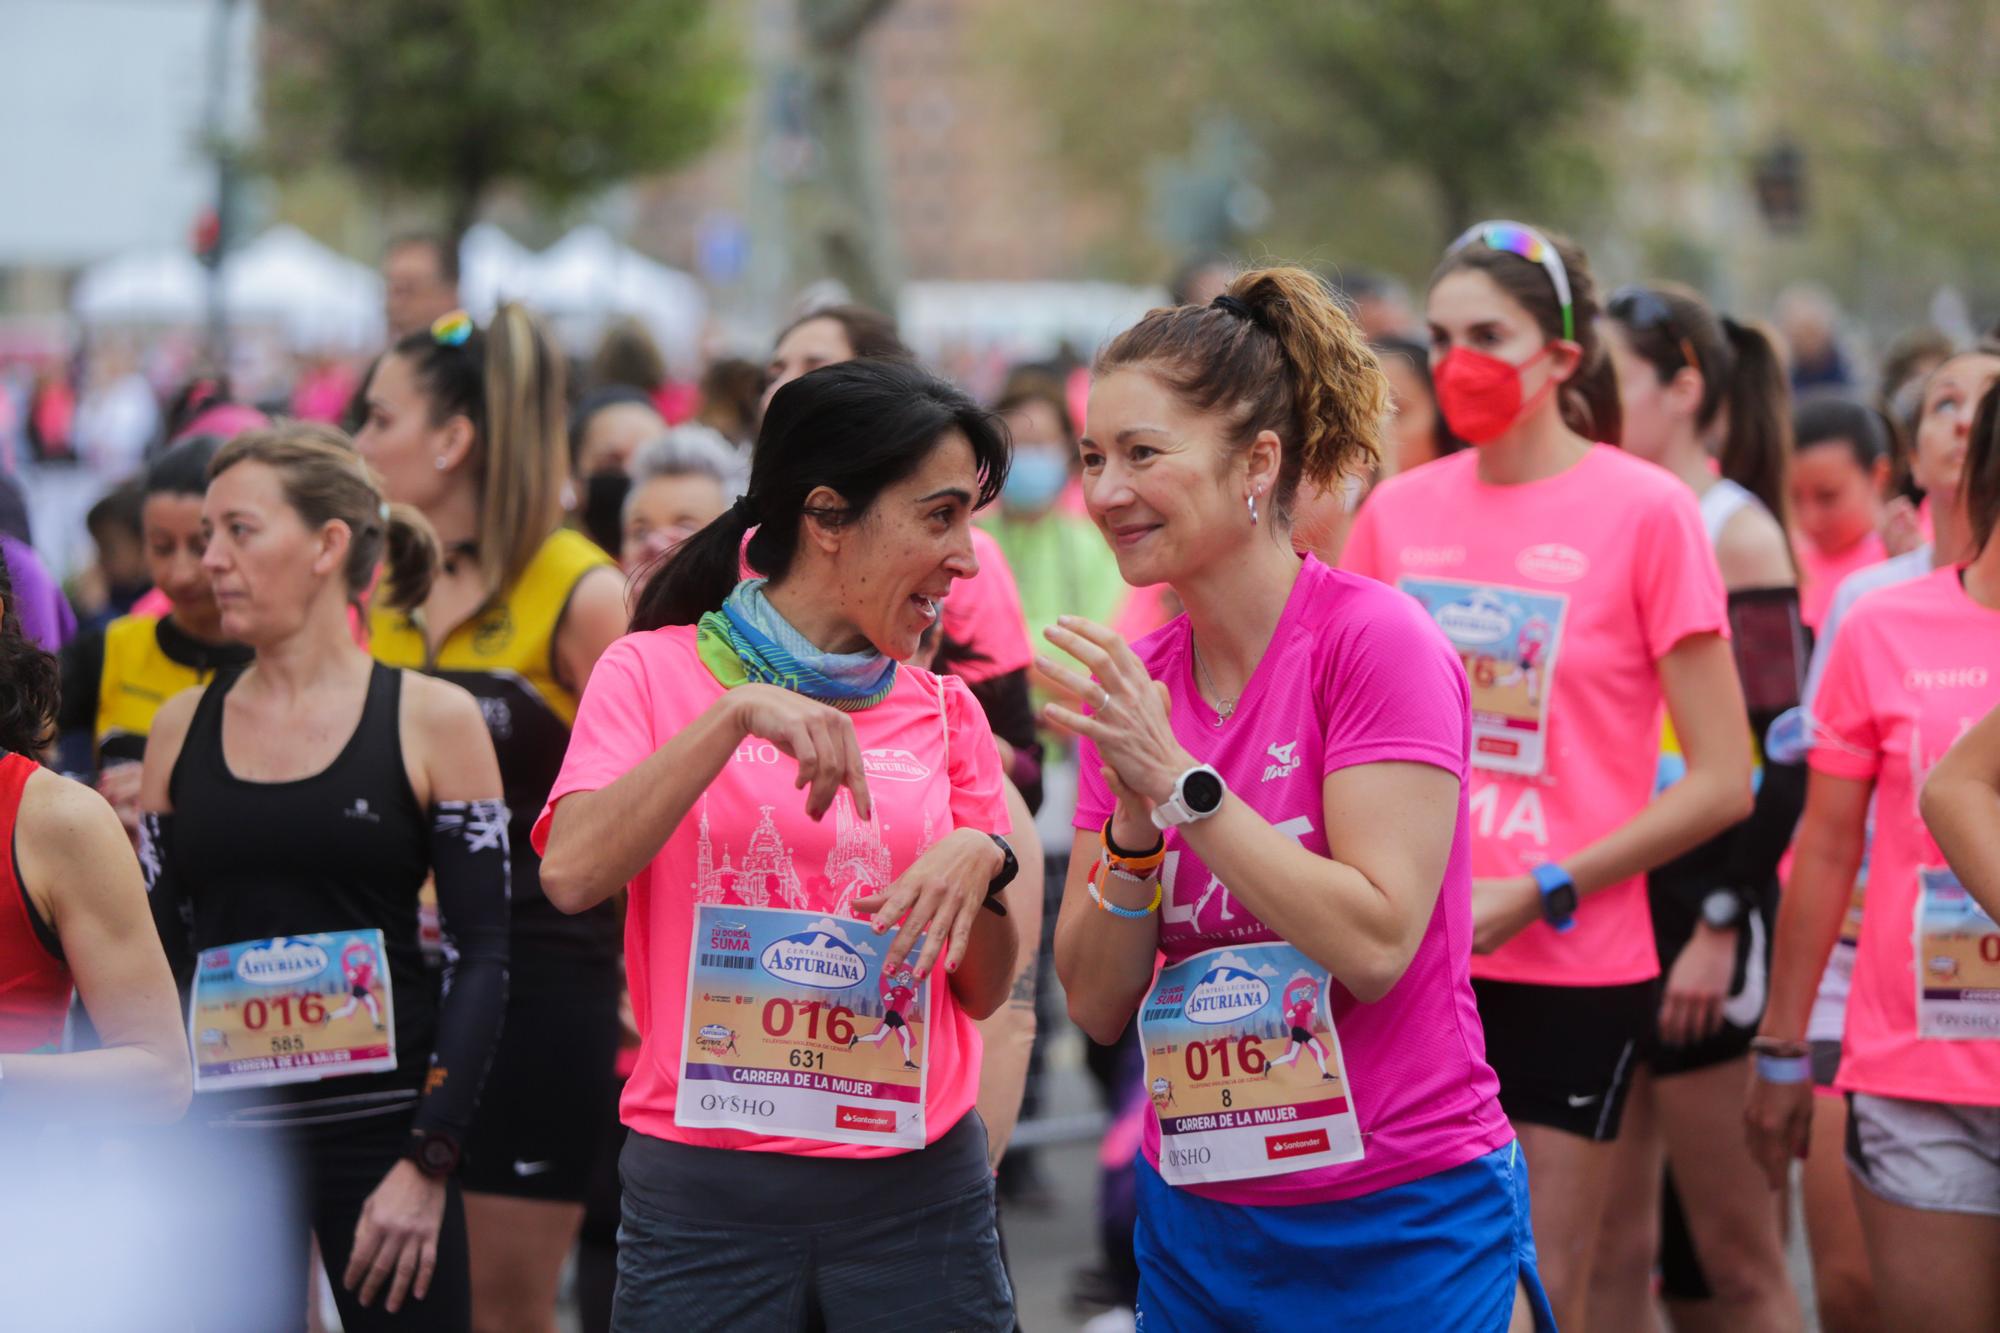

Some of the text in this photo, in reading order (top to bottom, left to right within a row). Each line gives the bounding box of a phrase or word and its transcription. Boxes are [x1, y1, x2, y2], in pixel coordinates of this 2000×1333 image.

[711, 937, 751, 951] SUMA
[722, 929, 752, 939] DORSAL
[768, 948, 859, 981] ASTURIANA
[243, 991, 326, 1031] 016
[1188, 991, 1262, 1015] ASTURIANA
[762, 997, 856, 1045] 016
[789, 1048, 824, 1070] 631
[1185, 1034, 1266, 1081] 016
[733, 1068, 873, 1096] CARRERA DE LA MUJER
[701, 1094, 775, 1117] OYSHO
[1222, 1088, 1232, 1108] 8
[853, 1114, 888, 1125] Santander
[1176, 1106, 1297, 1132] CARRERA DE LA MUJER
[1282, 1137, 1321, 1151] Santander
[1168, 1146, 1211, 1168] OYSHO
